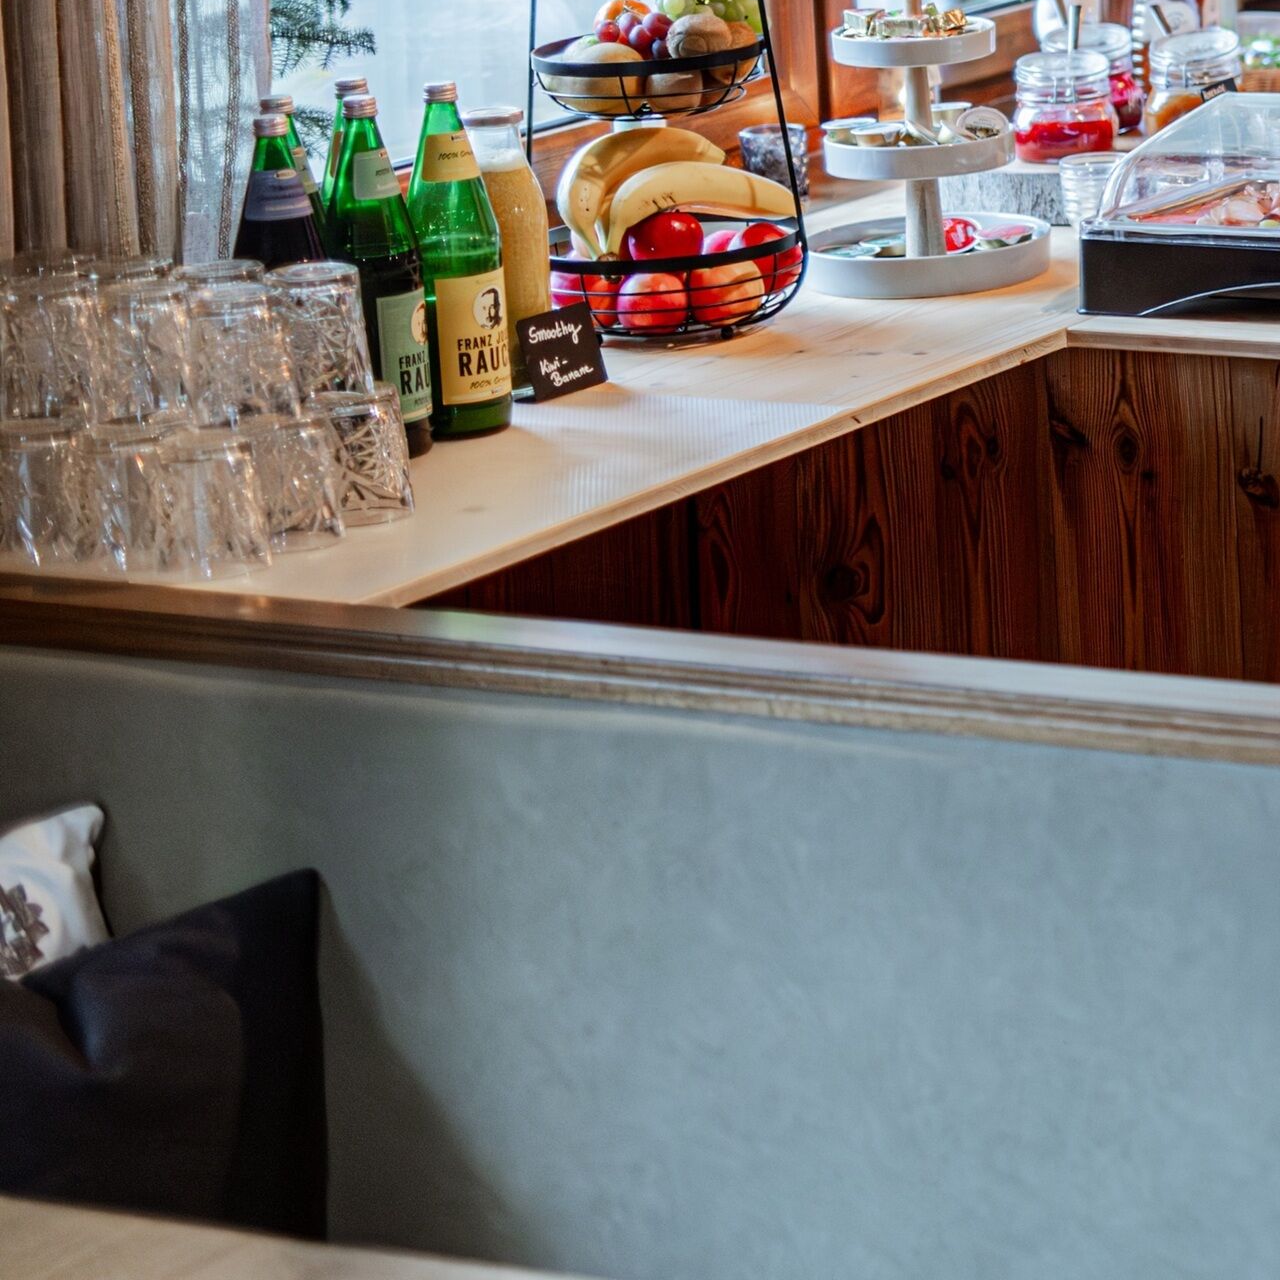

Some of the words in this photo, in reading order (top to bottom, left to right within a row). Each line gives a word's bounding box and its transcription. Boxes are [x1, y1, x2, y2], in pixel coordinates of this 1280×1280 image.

[457, 334, 493, 352] FRANZ
[528, 320, 583, 345] Smoothy
[458, 344, 508, 377] RAUC
[400, 363, 430, 396] RAU
[550, 365, 594, 387] Banane
